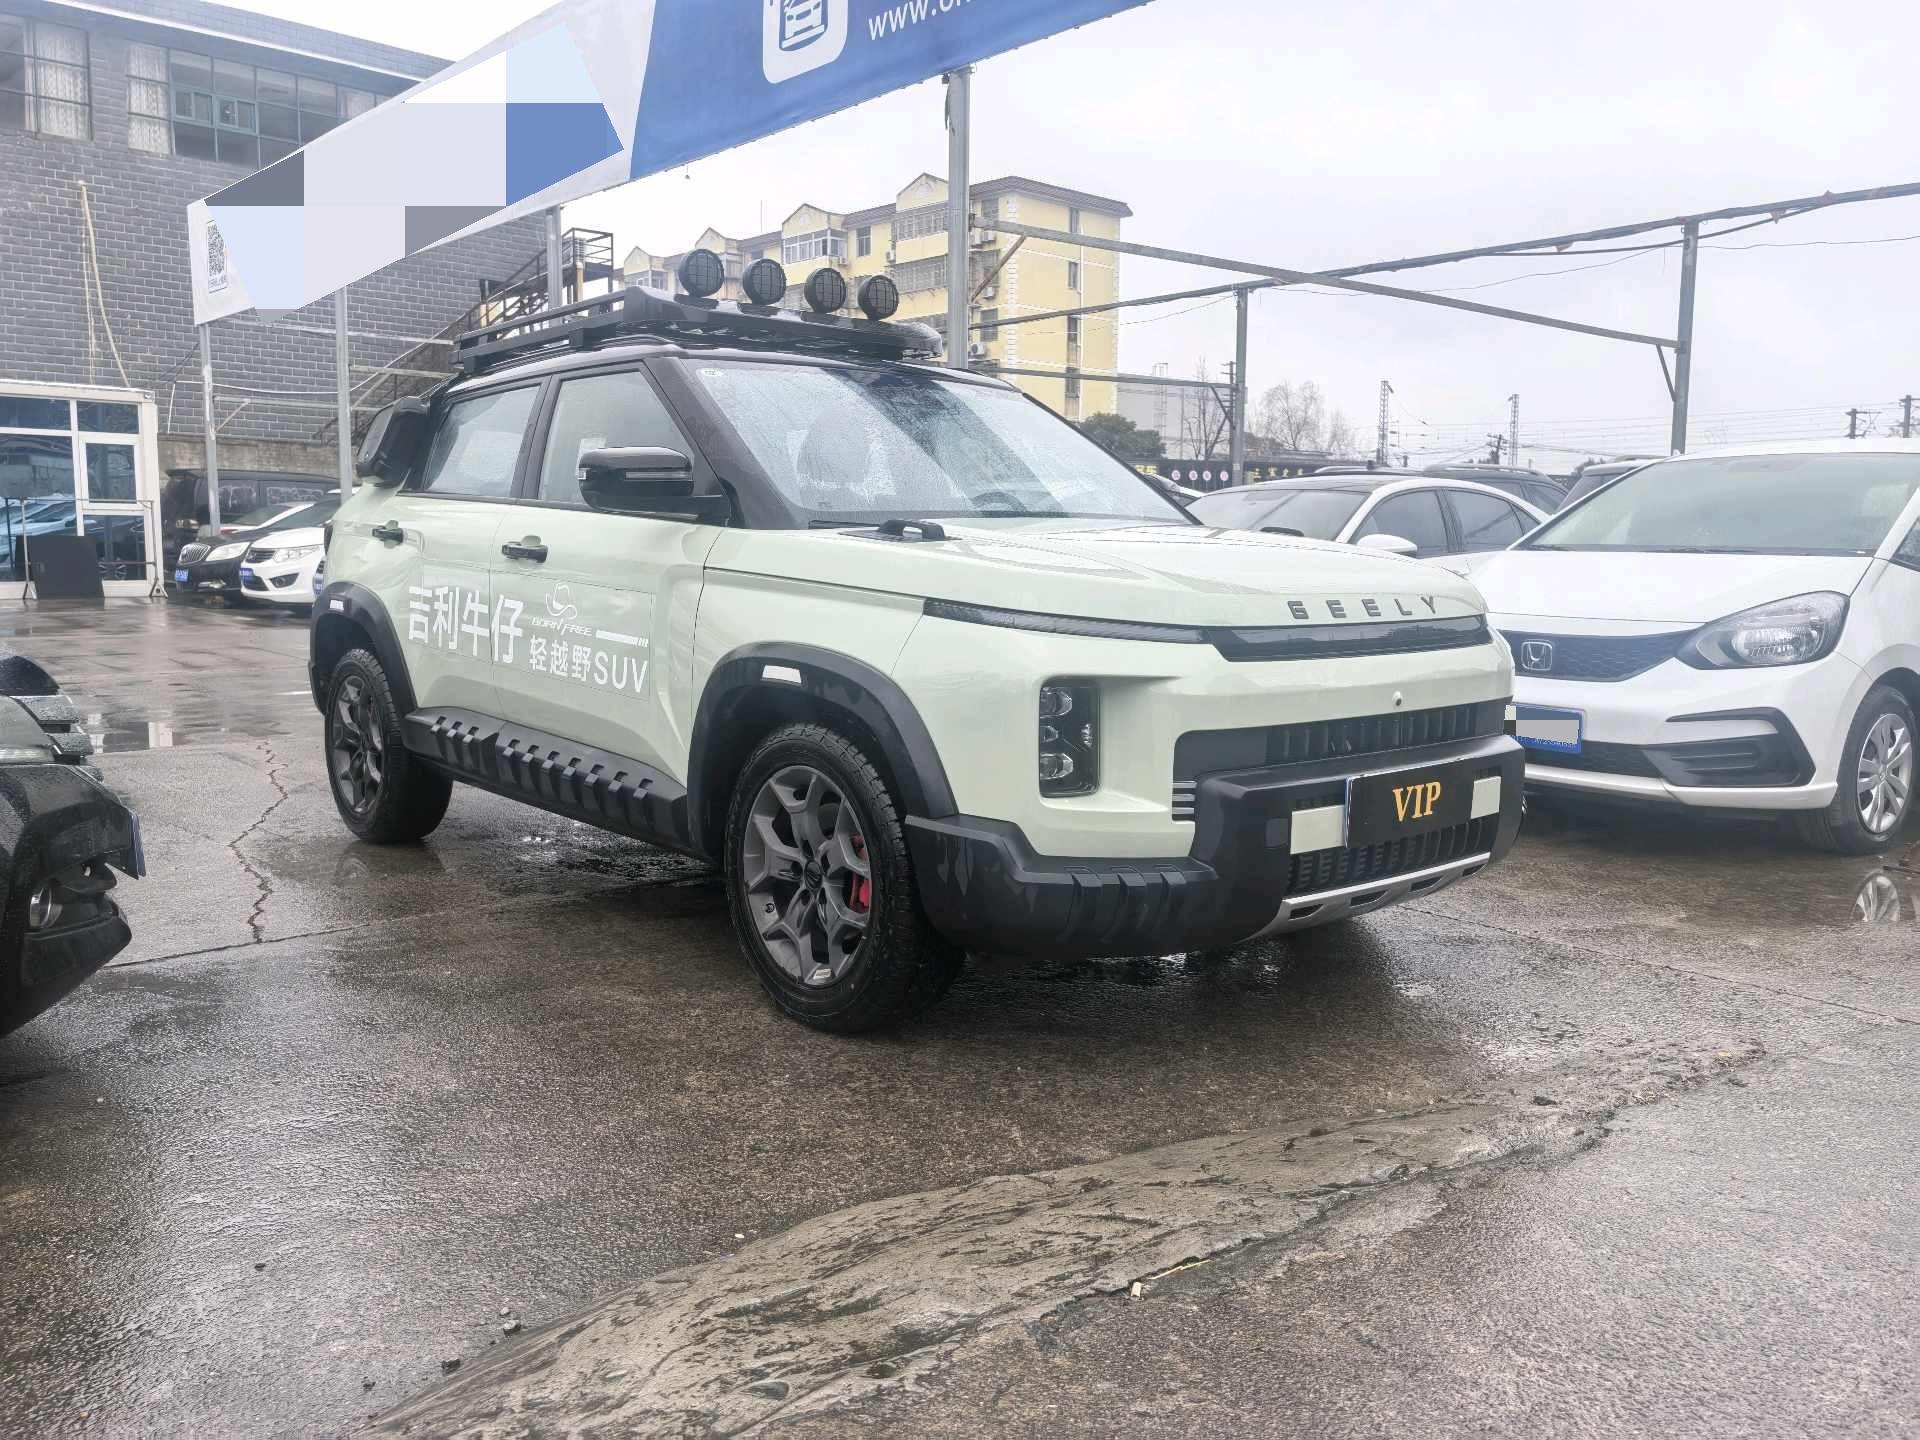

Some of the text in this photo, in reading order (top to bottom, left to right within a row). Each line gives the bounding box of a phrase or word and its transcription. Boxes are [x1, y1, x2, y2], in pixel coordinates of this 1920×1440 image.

[408, 586, 524, 664] 吉利牛仔
[1287, 595, 1437, 620] GEELY
[1391, 780, 1442, 823] VIP
